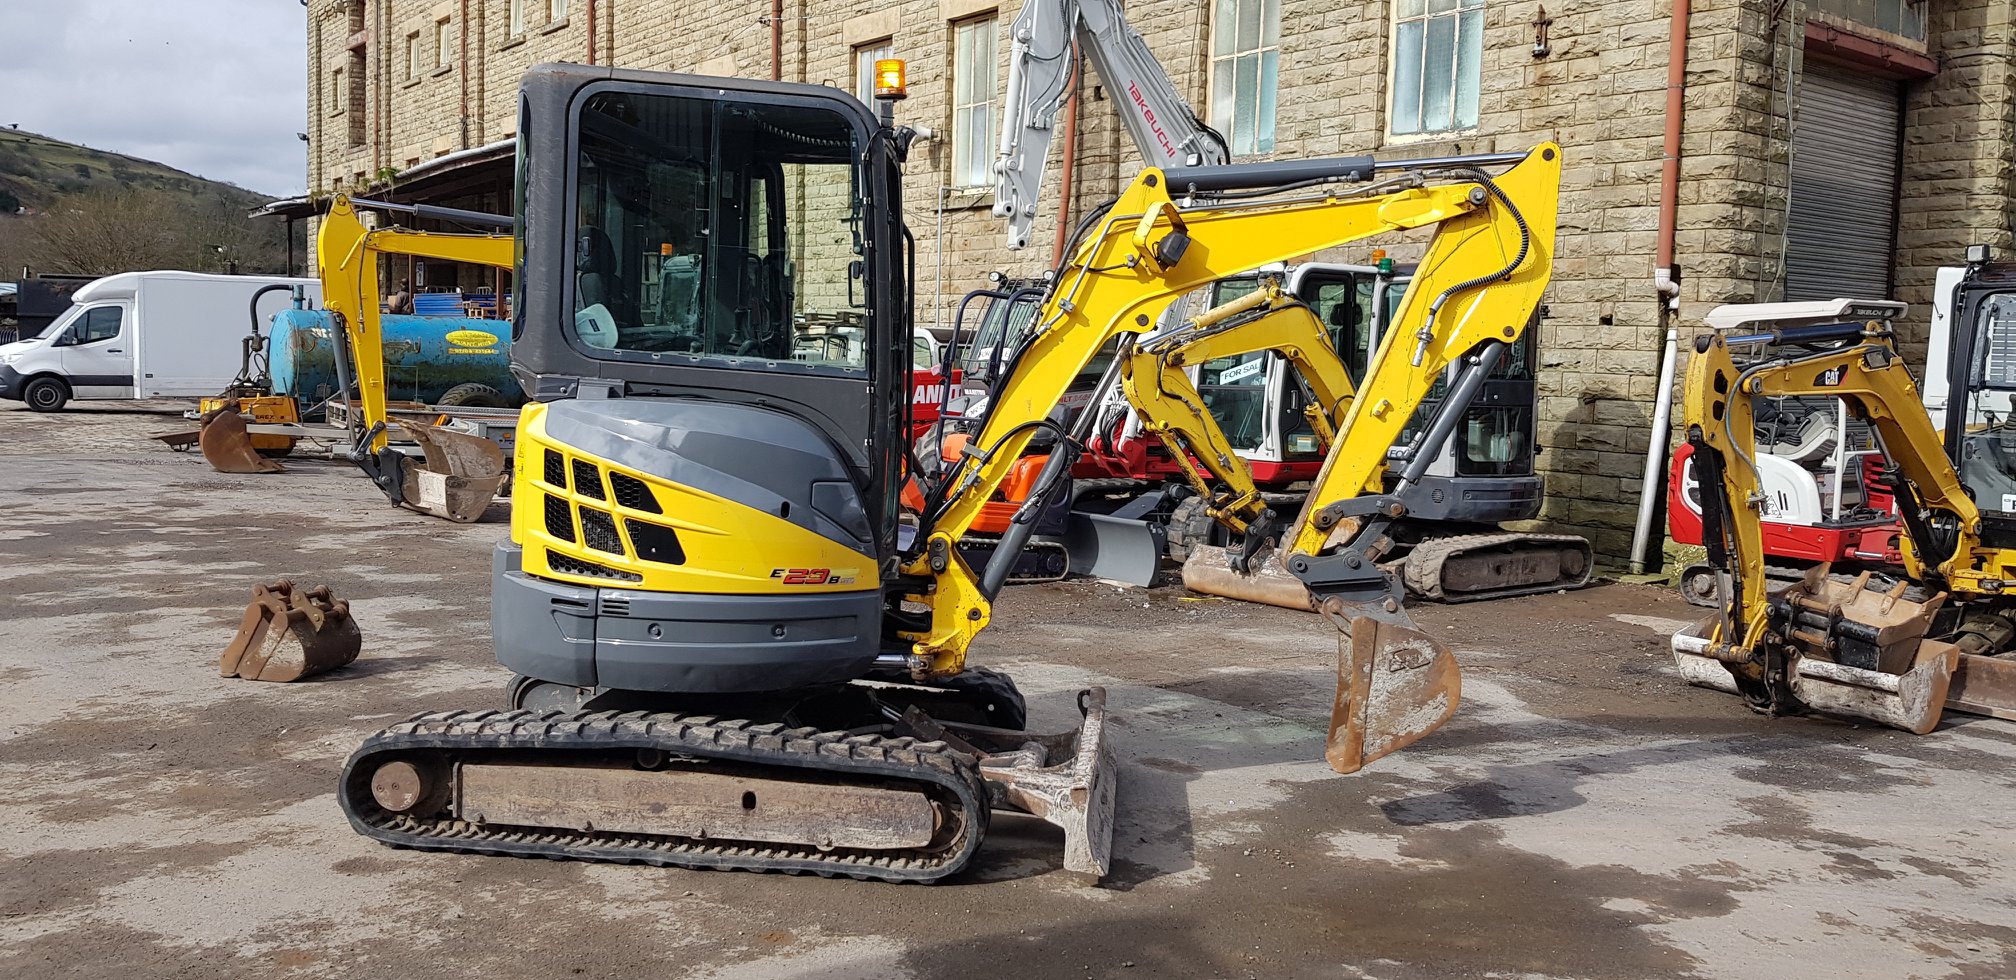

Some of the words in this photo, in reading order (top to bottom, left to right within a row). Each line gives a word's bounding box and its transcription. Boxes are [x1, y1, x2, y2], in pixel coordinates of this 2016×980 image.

[1224, 369, 1242, 380] FOR
[1243, 363, 1260, 373] SAL
[1825, 371, 1840, 385] CAT
